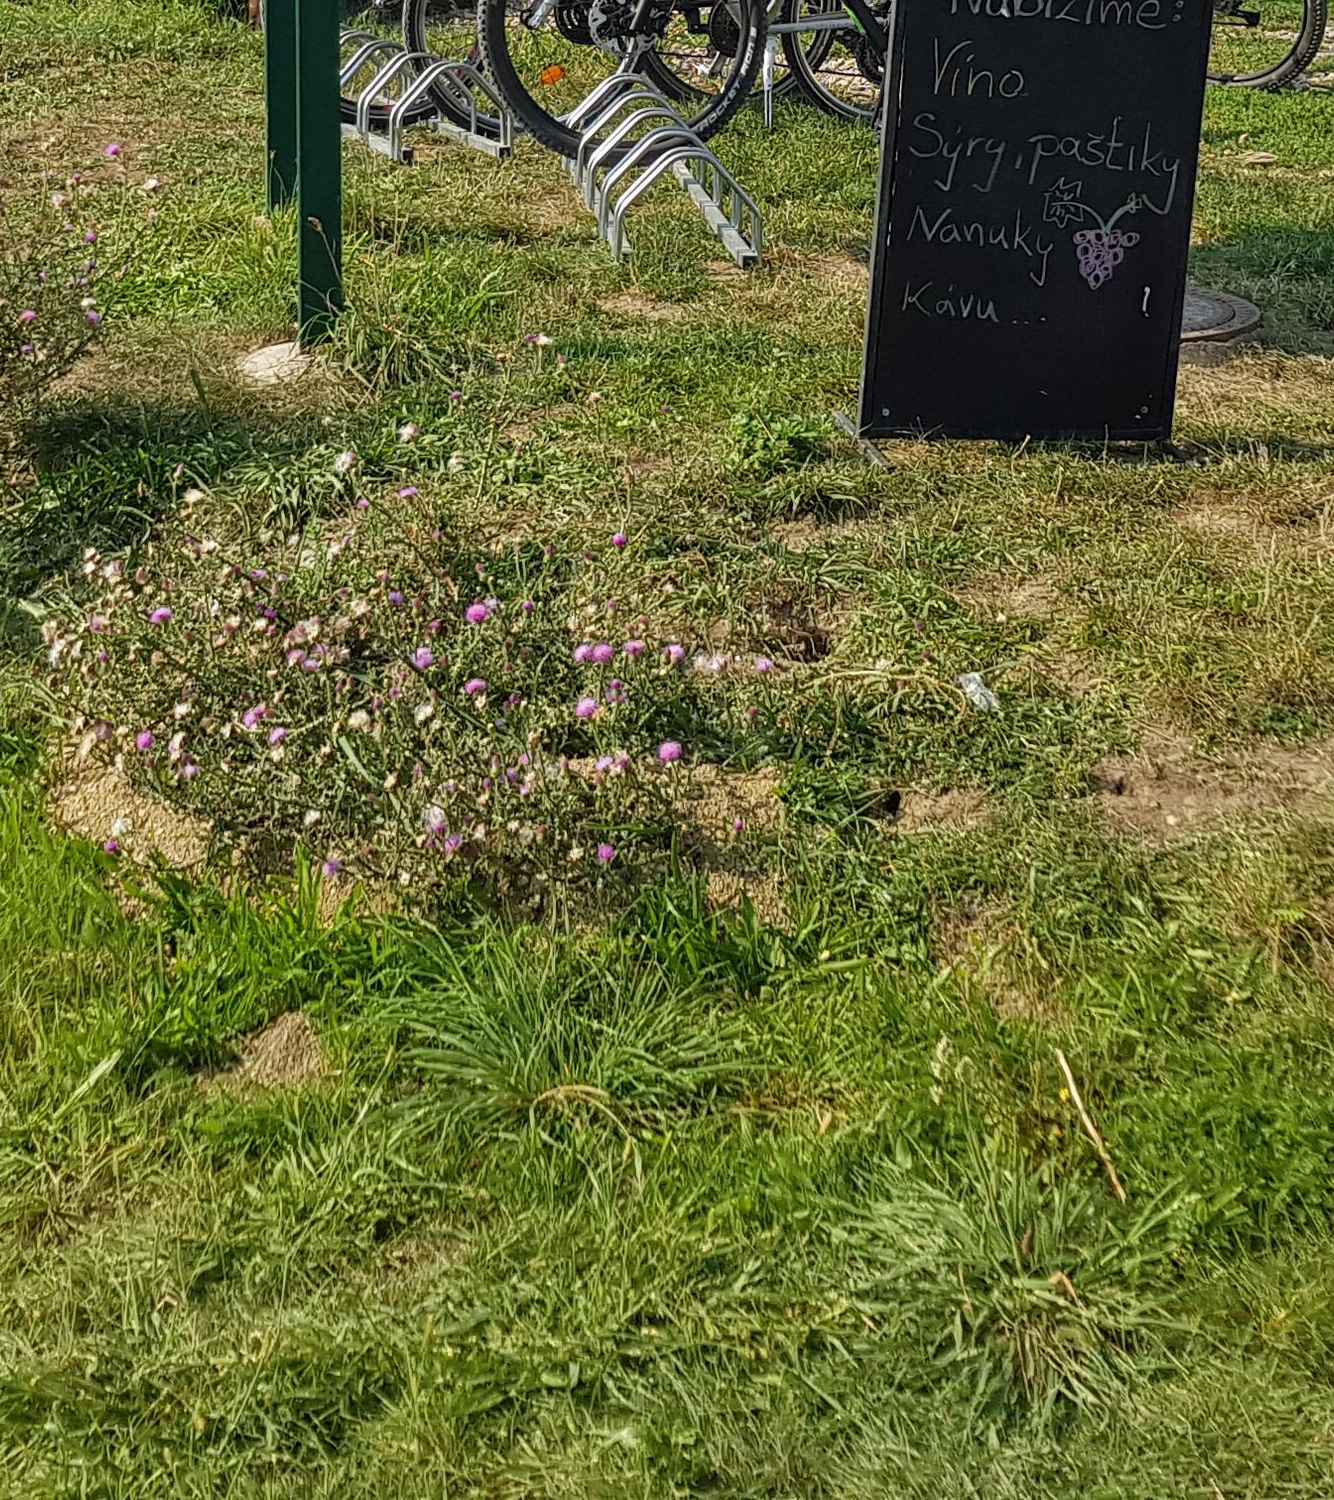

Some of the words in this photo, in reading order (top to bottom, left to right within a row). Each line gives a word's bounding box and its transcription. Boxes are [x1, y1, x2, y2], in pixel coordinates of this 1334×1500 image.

[933, 37, 1027, 98] Víno
[1028, 116, 1180, 215] paštiky
[907, 204, 1053, 287] Nanuky
